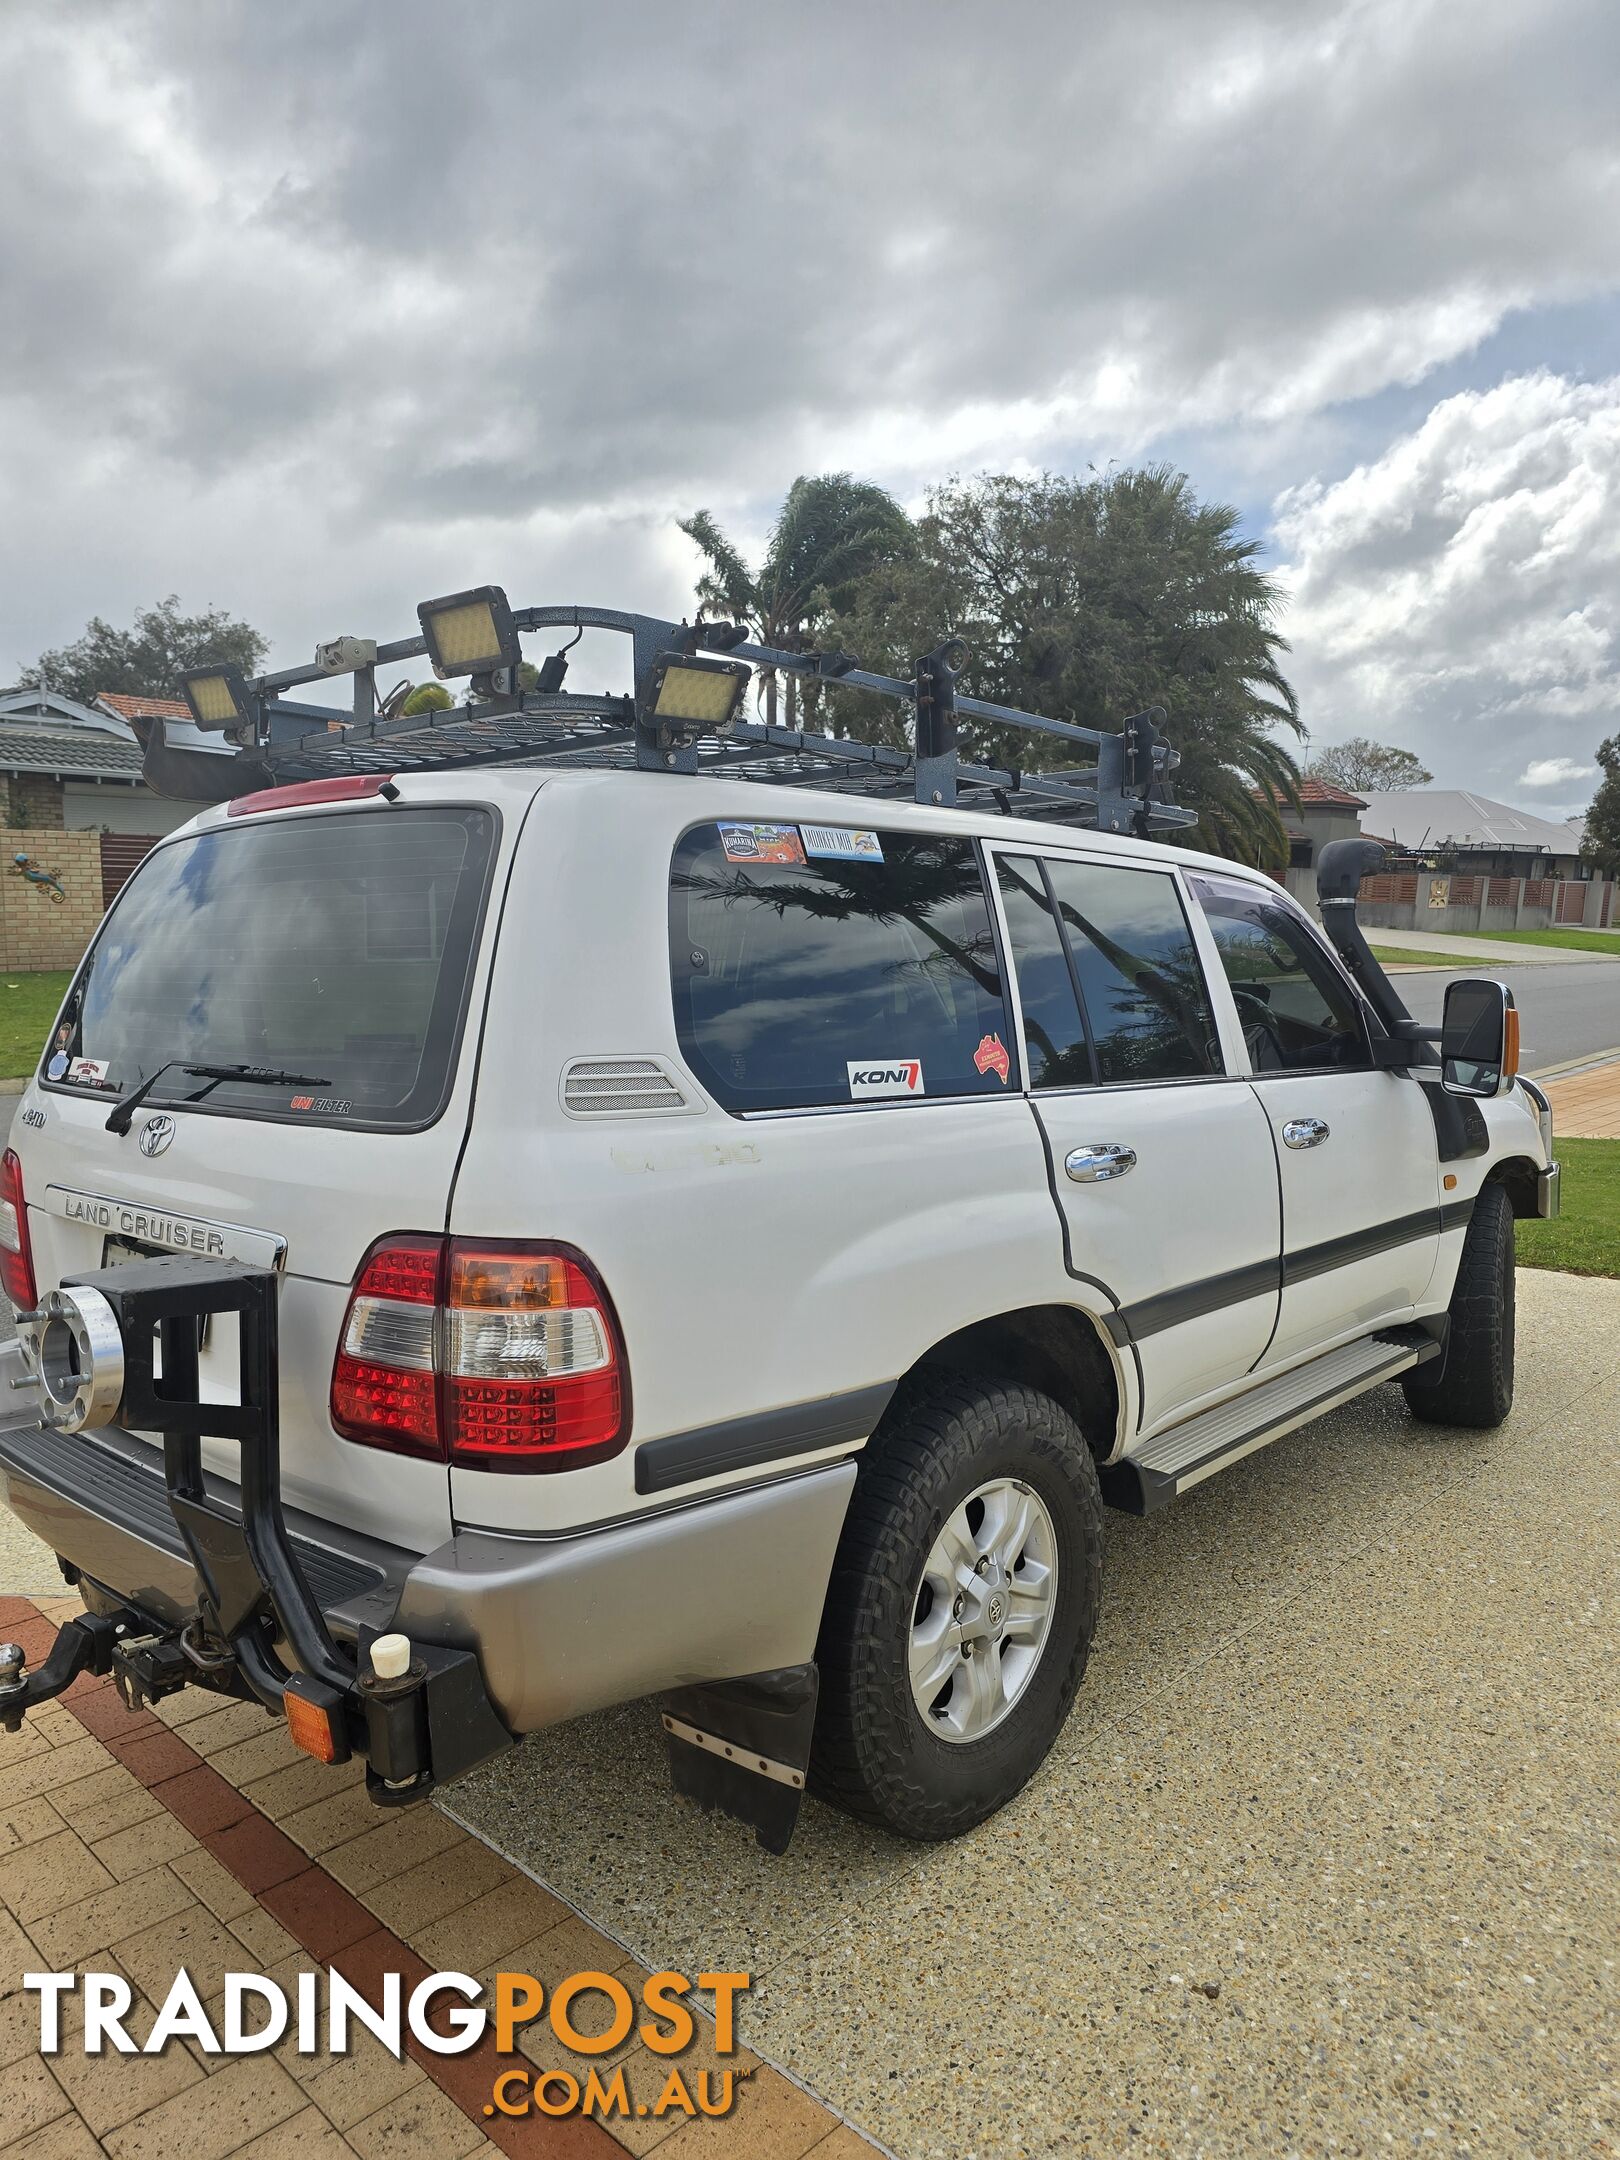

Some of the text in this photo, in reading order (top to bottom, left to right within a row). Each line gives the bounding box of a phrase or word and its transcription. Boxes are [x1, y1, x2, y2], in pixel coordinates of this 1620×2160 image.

[804, 829, 853, 851] MONKEY MIA
[852, 1069, 908, 1085] KONI
[290, 1095, 352, 1114] UNI FILTER
[65, 1195, 225, 1256] LAND CRUISER
